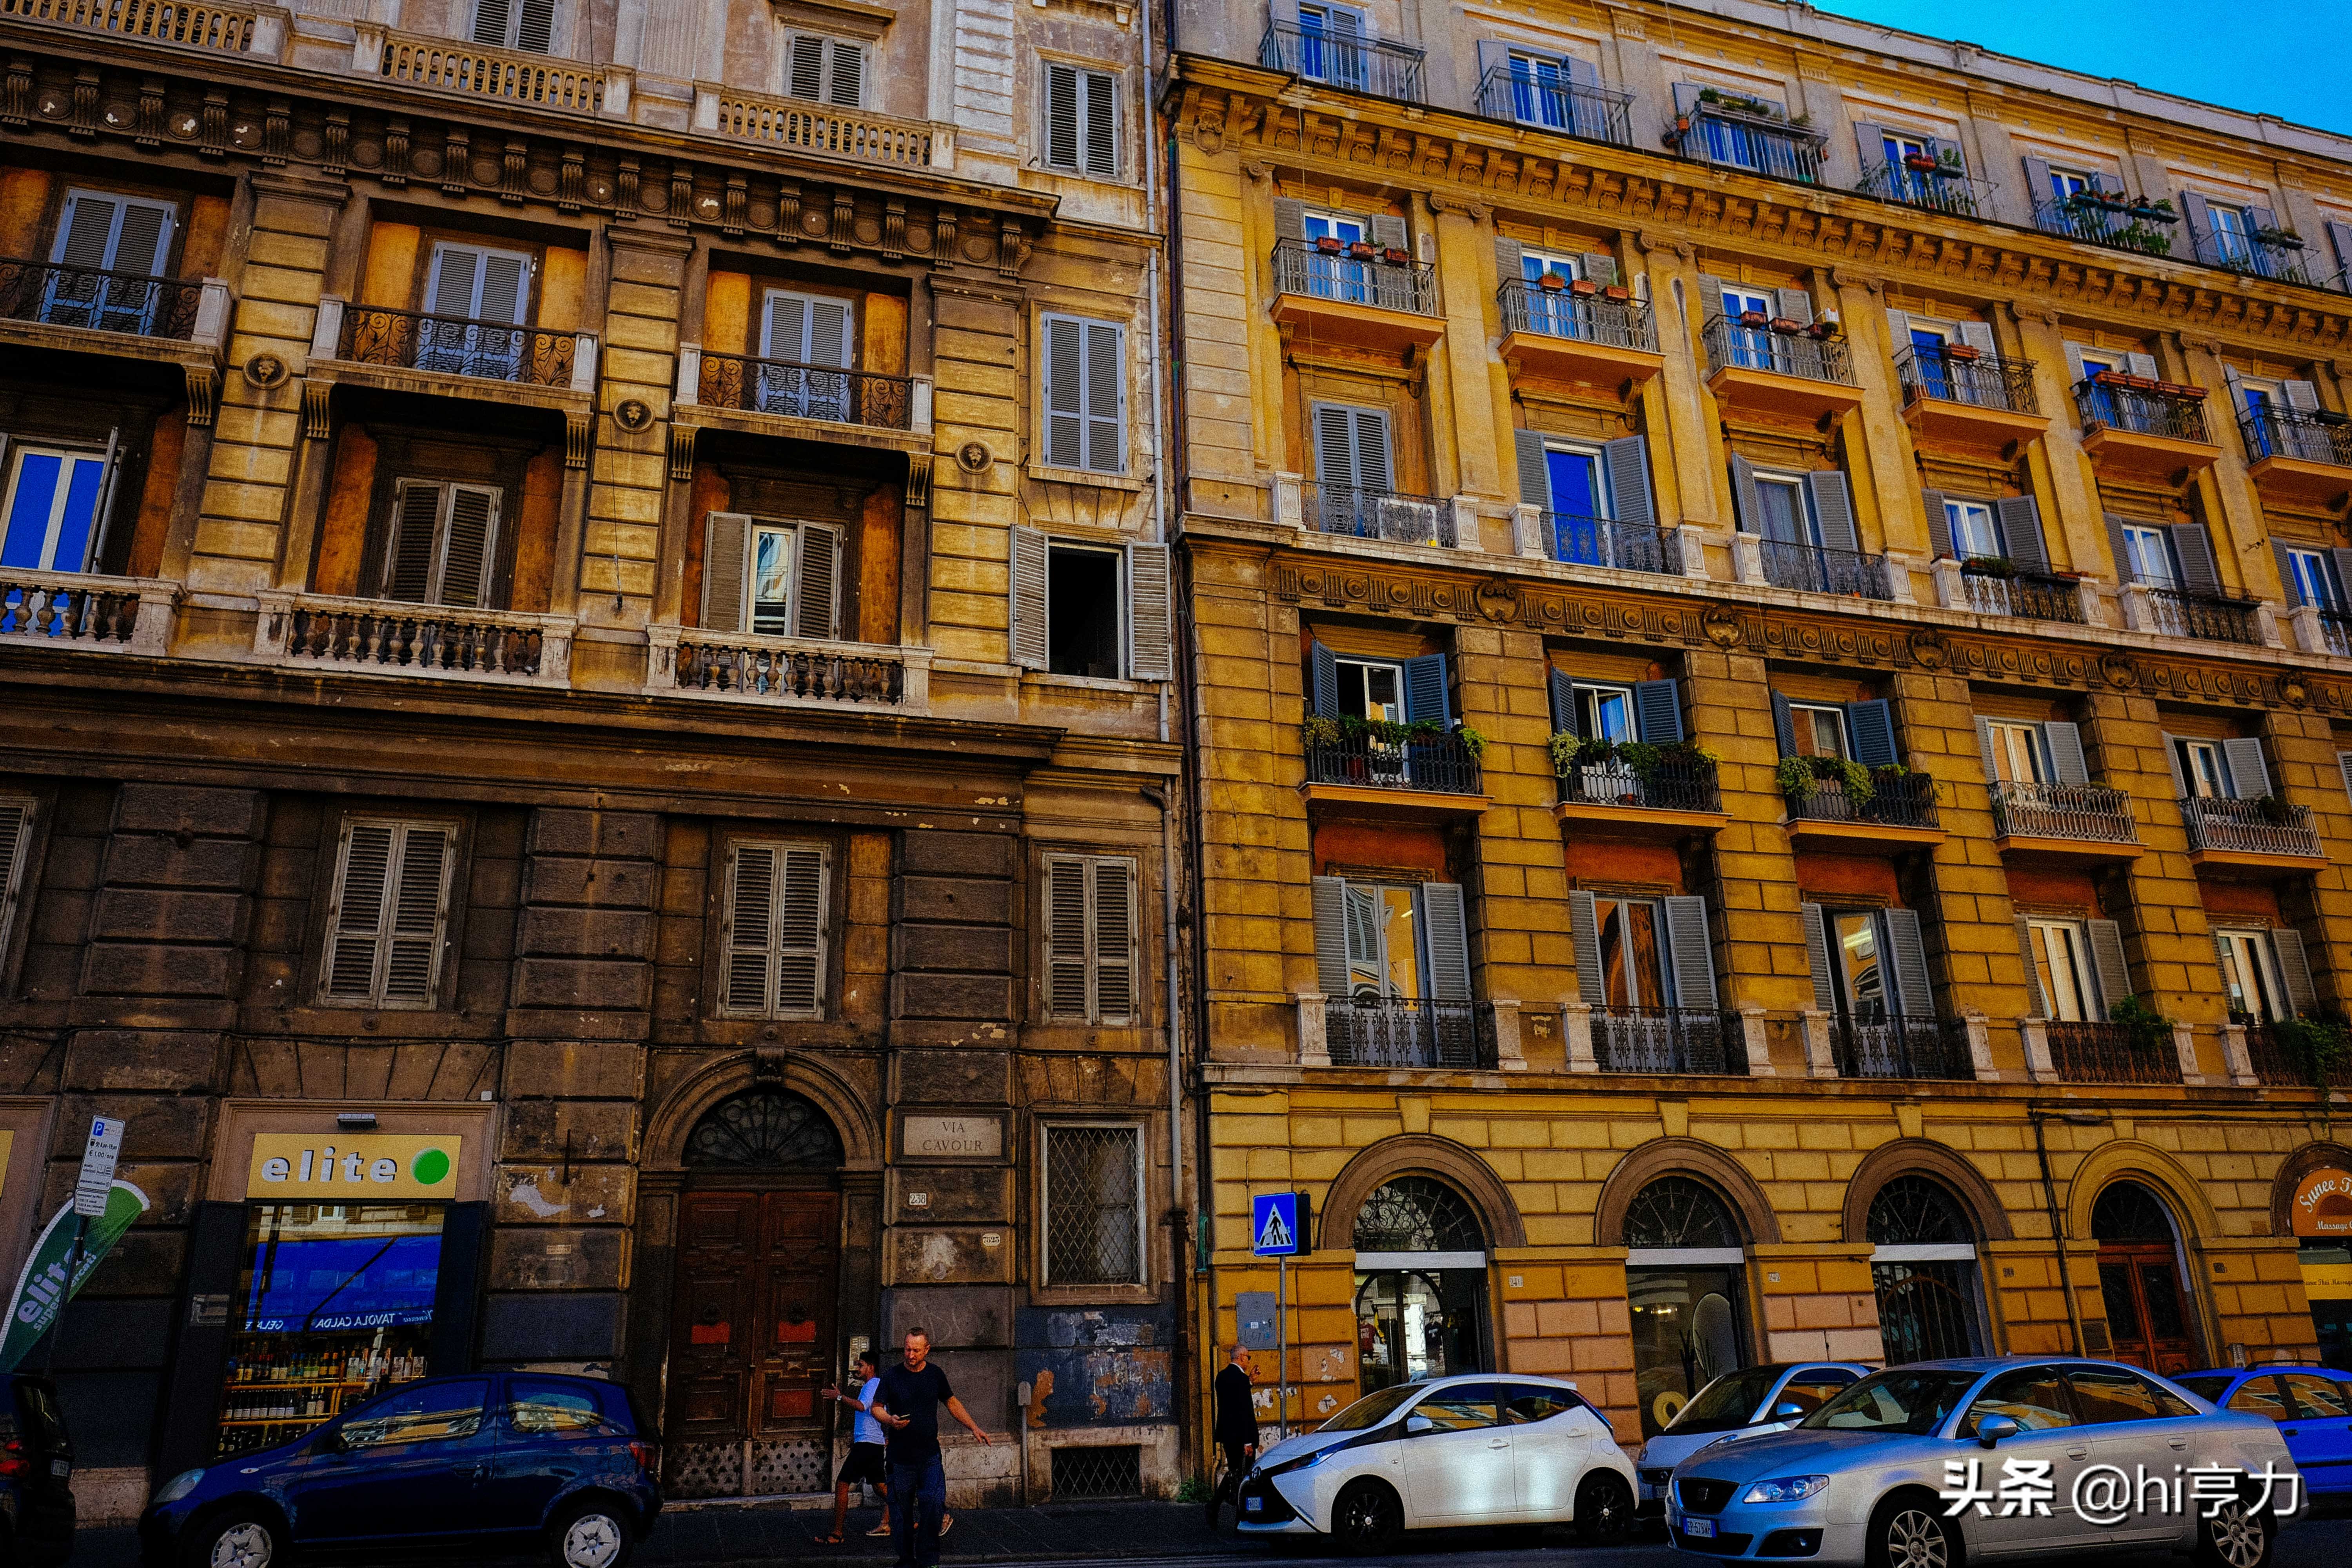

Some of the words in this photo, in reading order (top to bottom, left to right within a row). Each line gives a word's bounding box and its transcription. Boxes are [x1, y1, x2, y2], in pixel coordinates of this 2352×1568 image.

[95, 1123, 103, 1134] P
[942, 1122, 965, 1133] VIA
[922, 1140, 983, 1151] CAVOUR
[261, 1146, 397, 1183] elite
[910, 1194, 926, 1204] 238
[2299, 1180, 2336, 1213] Sunee
[2339, 1177, 2352, 1195] T
[2316, 1220, 2348, 1232] Massage
